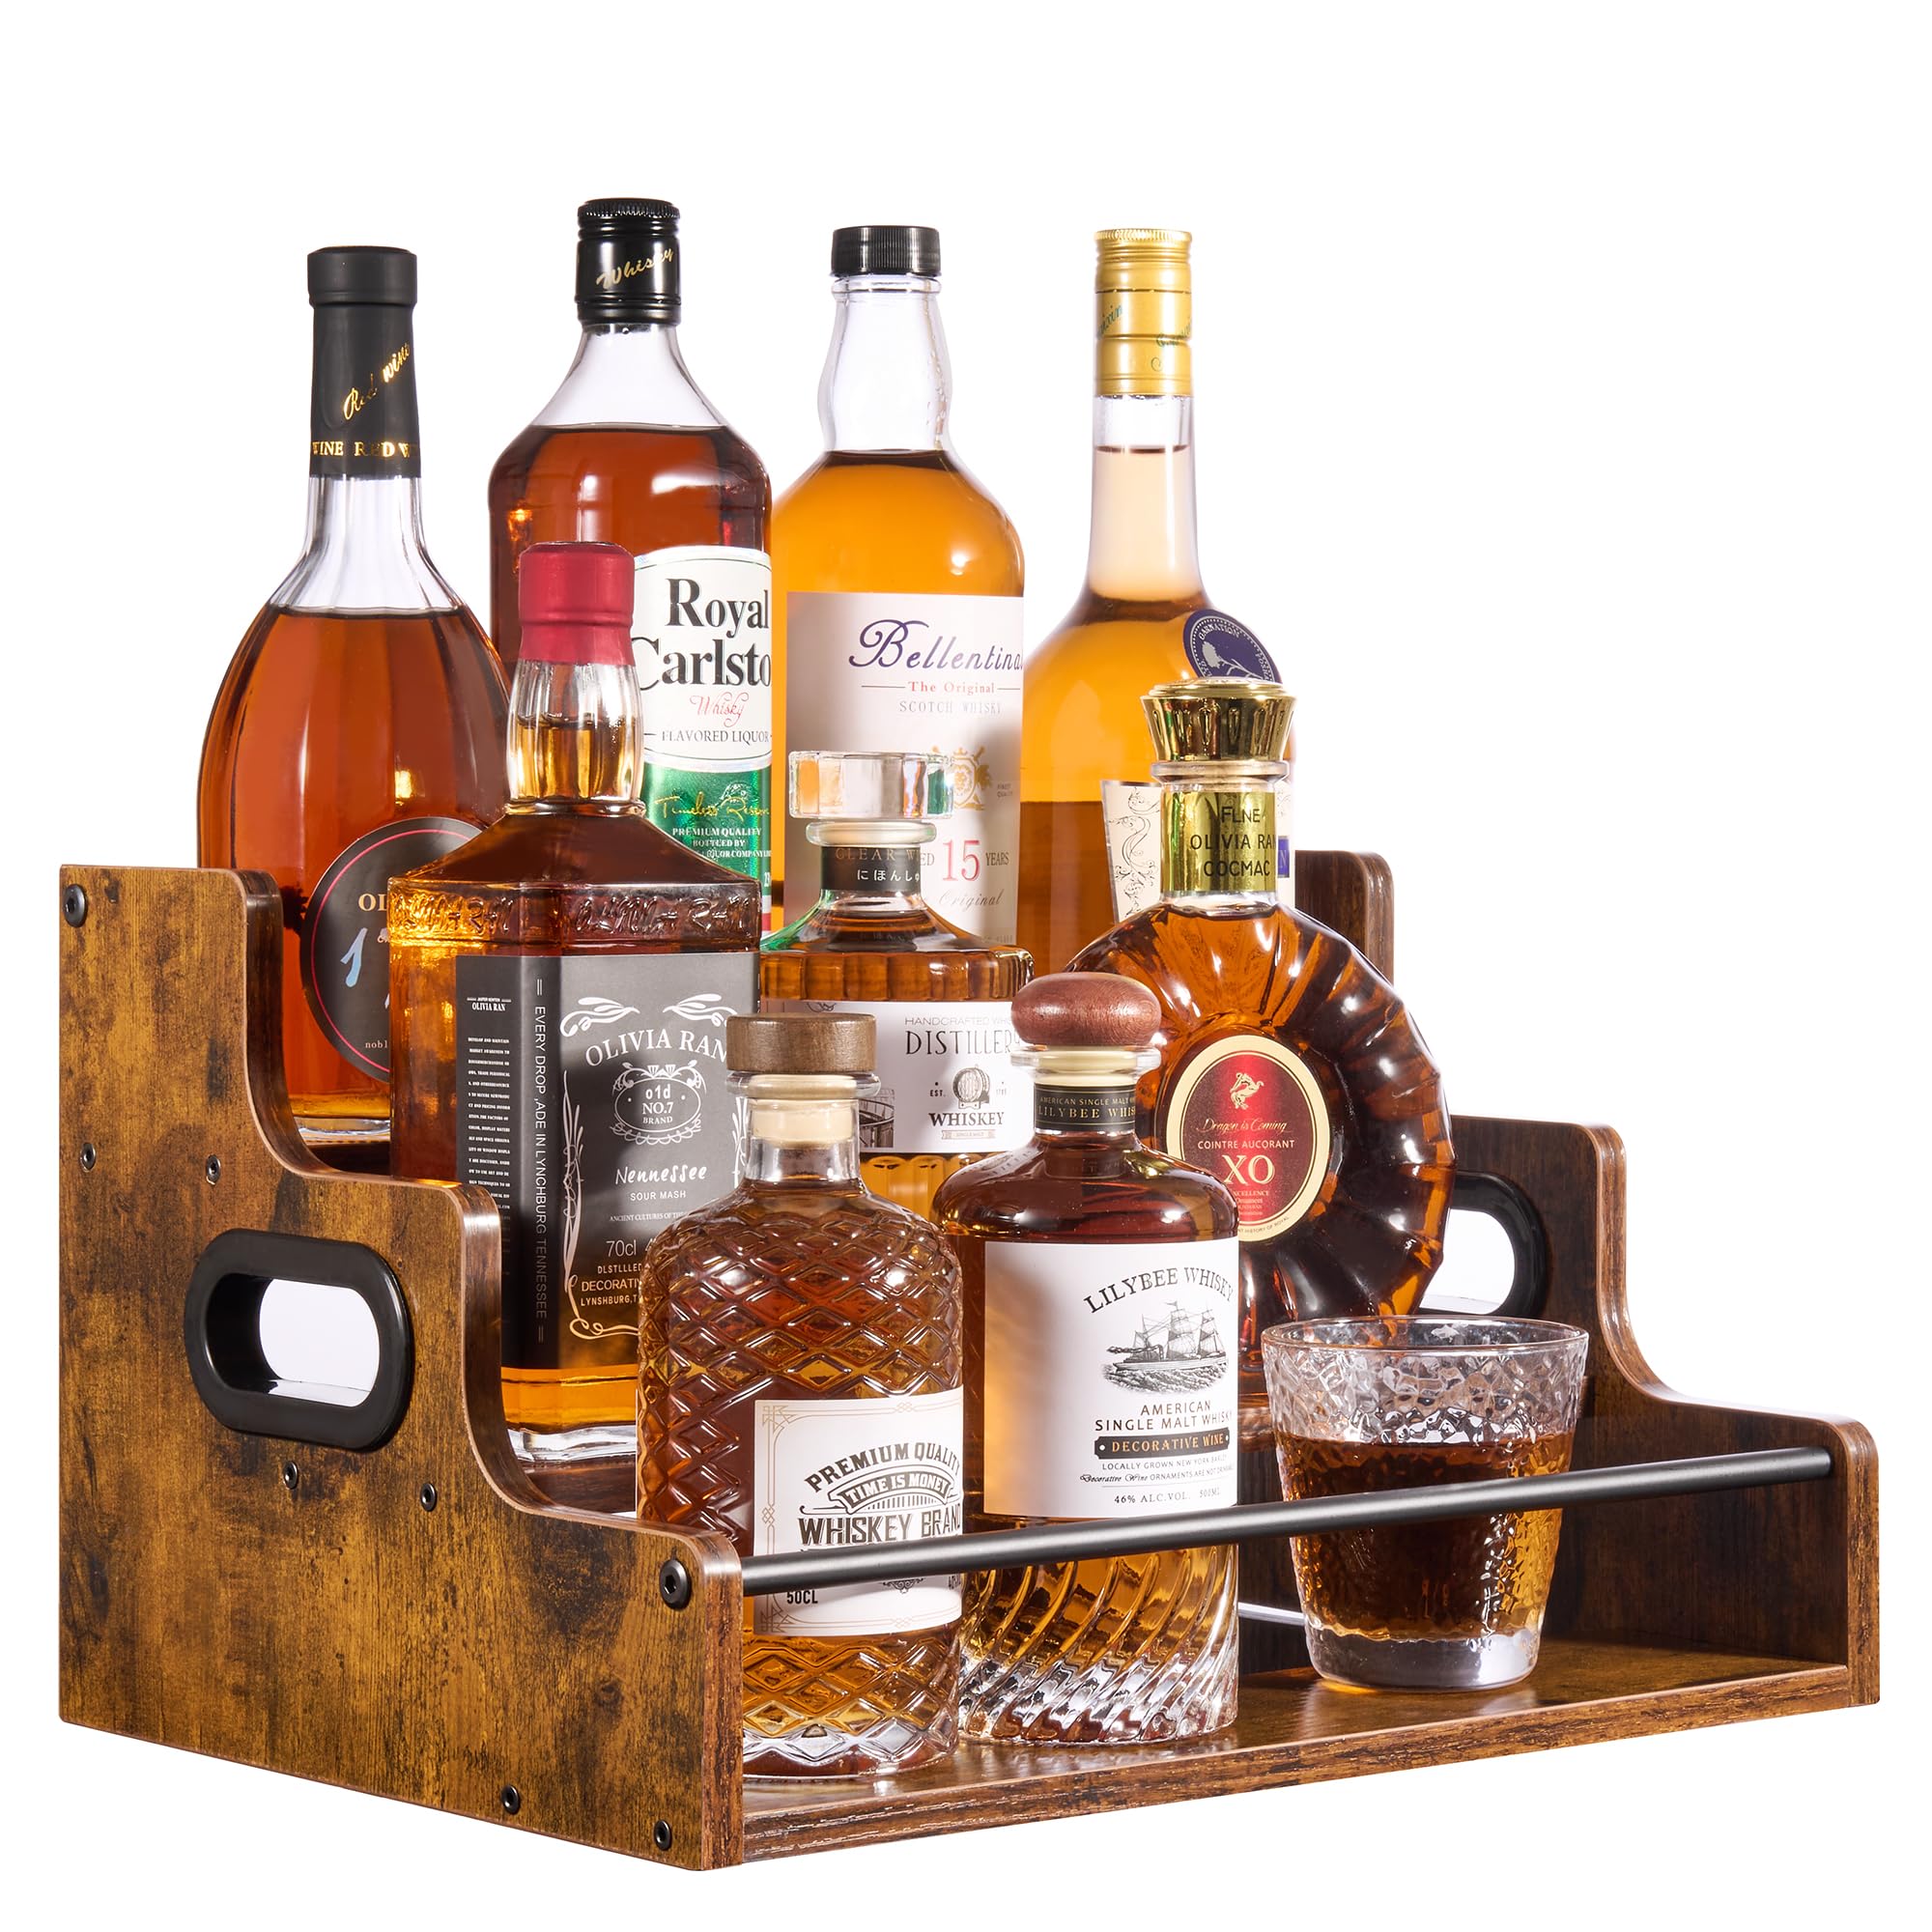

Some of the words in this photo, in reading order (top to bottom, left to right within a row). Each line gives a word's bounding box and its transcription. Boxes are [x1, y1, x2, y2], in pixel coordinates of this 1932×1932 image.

[595, 247, 674, 290] Whisy
[665, 577, 770, 639] Royal
[848, 618, 1024, 670] Bellentina
[908, 680, 937, 693] The
[943, 682, 996, 696] Original
[689, 691, 750, 728] Whisky
[898, 700, 953, 714] SCOTCH
[661, 729, 729, 743] FLAVORED
[731, 730, 770, 746] LIQUOR
[672, 827, 720, 837] PREMIUM
[721, 827, 762, 838] QUALITY
[693, 838, 733, 847] BOTTLED
[734, 838, 746, 847] BY
[1190, 834, 1251, 850] OLIVIA
[835, 848, 896, 862] CLEAR
[942, 838, 981, 882] 15
[984, 852, 1010, 867] YEARS
[939, 889, 1006, 912] Original
[471, 1002, 493, 1011] OLIVIA
[904, 1016, 990, 1026] HANDCRAFTED
[534, 1007, 547, 1052] EVERY
[585, 1028, 672, 1066] OLIVIA
[678, 1030, 727, 1064] RAN
[534, 1056, 547, 1094] DROP
[929, 1089, 947, 1098] EST.
[1039, 1096, 1076, 1105] AMERICAN
[1079, 1097, 1110, 1106] SINGLE
[641, 1101, 674, 1115] NO.7
[1037, 1105, 1100, 1119] LILYBEE
[642, 1116, 674, 1125] BRAND
[927, 1112, 1006, 1127] WHISKEY
[1195, 1117, 1239, 1135] Dragon
[1240, 1120, 1249, 1130] is
[1247, 1118, 1292, 1136] Coming
[535, 1133, 547, 1147] IN
[1197, 1140, 1238, 1150] COINTRE
[1241, 1140, 1295, 1150] AUCORANT
[1221, 1154, 1276, 1185] XO
[535, 1150, 547, 1235] LYNCHBURG
[630, 1191, 657, 1202] SOUR
[659, 1190, 687, 1200] MASH
[606, 1238, 638, 1257] 70cl
[535, 1239, 548, 1320] TENNESSEE
[1083, 1267, 1179, 1314] LILYBEE
[1183, 1266, 1235, 1302] WHISKY
[1140, 1400, 1211, 1416] AMERICAN
[1094, 1418, 1154, 1433] SINGLE
[1160, 1415, 1198, 1430] MALT
[1112, 1436, 1199, 1453] DECORATIVE
[1203, 1433, 1224, 1447] WINE
[804, 1442, 910, 1493] PREMIUM
[914, 1441, 961, 1476] QUALITY
[1101, 1462, 1142, 1471] LOCALLY
[1144, 1461, 1175, 1470] GROWN
[1177, 1459, 1192, 1467] NEW
[1194, 1457, 1209, 1465] YORK
[1079, 1473, 1122, 1483] Decorative
[1124, 1473, 1149, 1483] Wine
[1150, 1470, 1193, 1482] ORNAMENTS
[1194, 1468, 1206, 1477] ARE
[845, 1476, 888, 1503] TIME
[891, 1474, 907, 1491] IS
[909, 1472, 950, 1494] MONEY
[1114, 1494, 1136, 1504] 46%
[797, 1513, 913, 1547] WHISKEY
[921, 1503, 961, 1539] BRAND
[786, 1590, 819, 1605] 50CL
